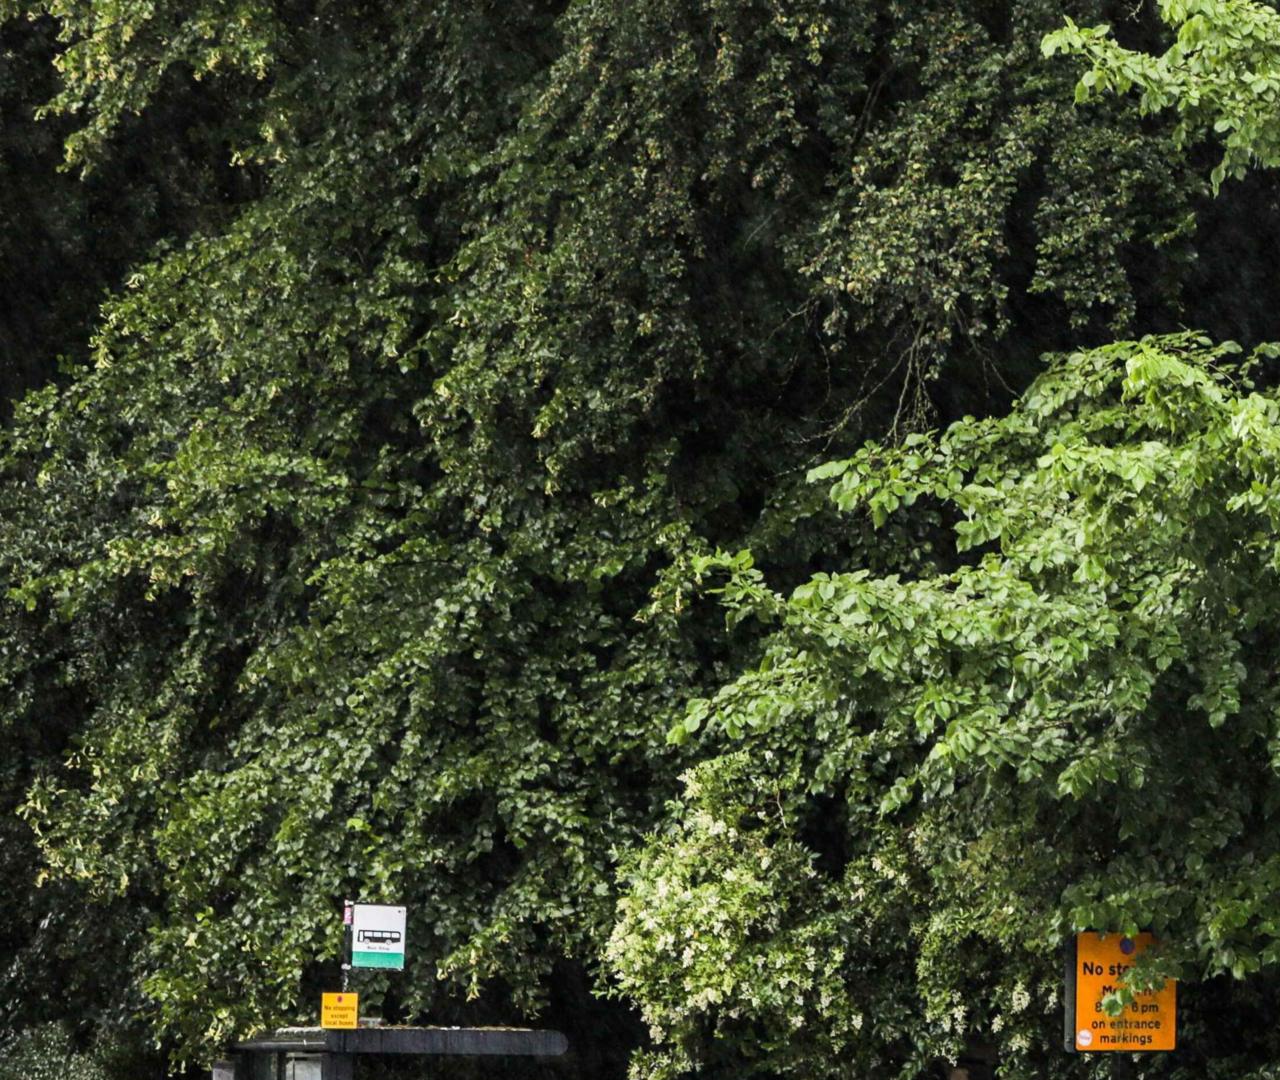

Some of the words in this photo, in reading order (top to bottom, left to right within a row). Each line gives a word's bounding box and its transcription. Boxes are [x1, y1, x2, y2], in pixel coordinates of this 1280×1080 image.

[1082, 962, 1104, 976] No
[1091, 1020, 1106, 1030] on
[1109, 1019, 1161, 1030] entrance
[1099, 1034, 1153, 1045] markings
